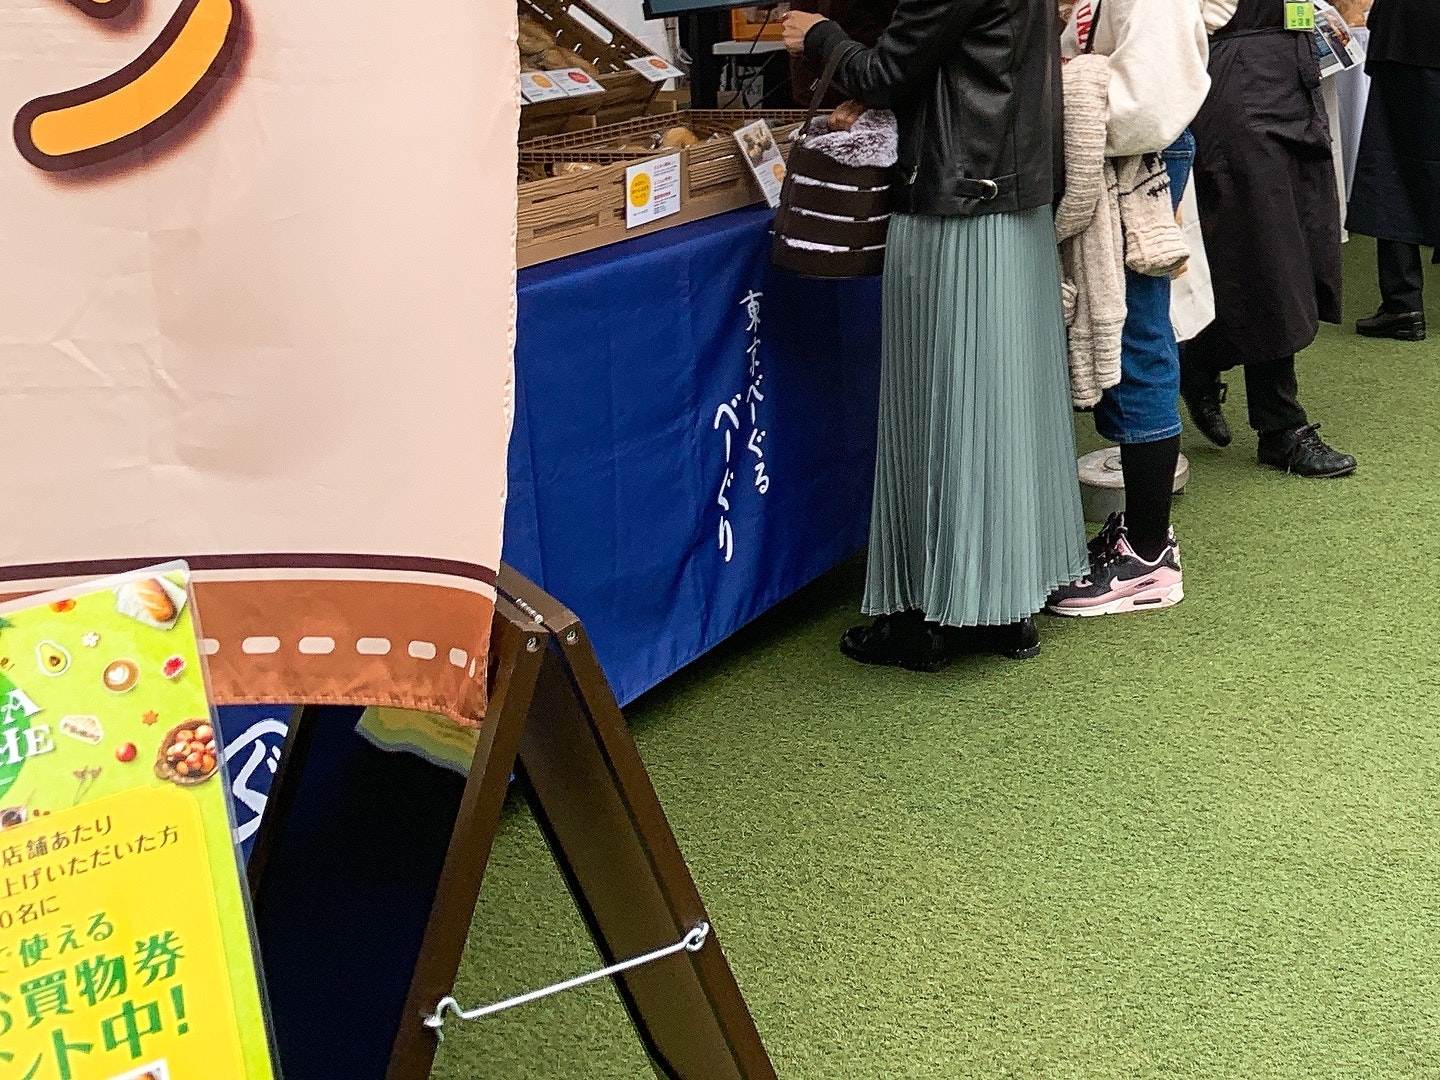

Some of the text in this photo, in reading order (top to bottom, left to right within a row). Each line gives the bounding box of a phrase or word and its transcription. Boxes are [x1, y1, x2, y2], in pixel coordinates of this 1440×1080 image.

[2, 815, 112, 868] 店舗あたり
